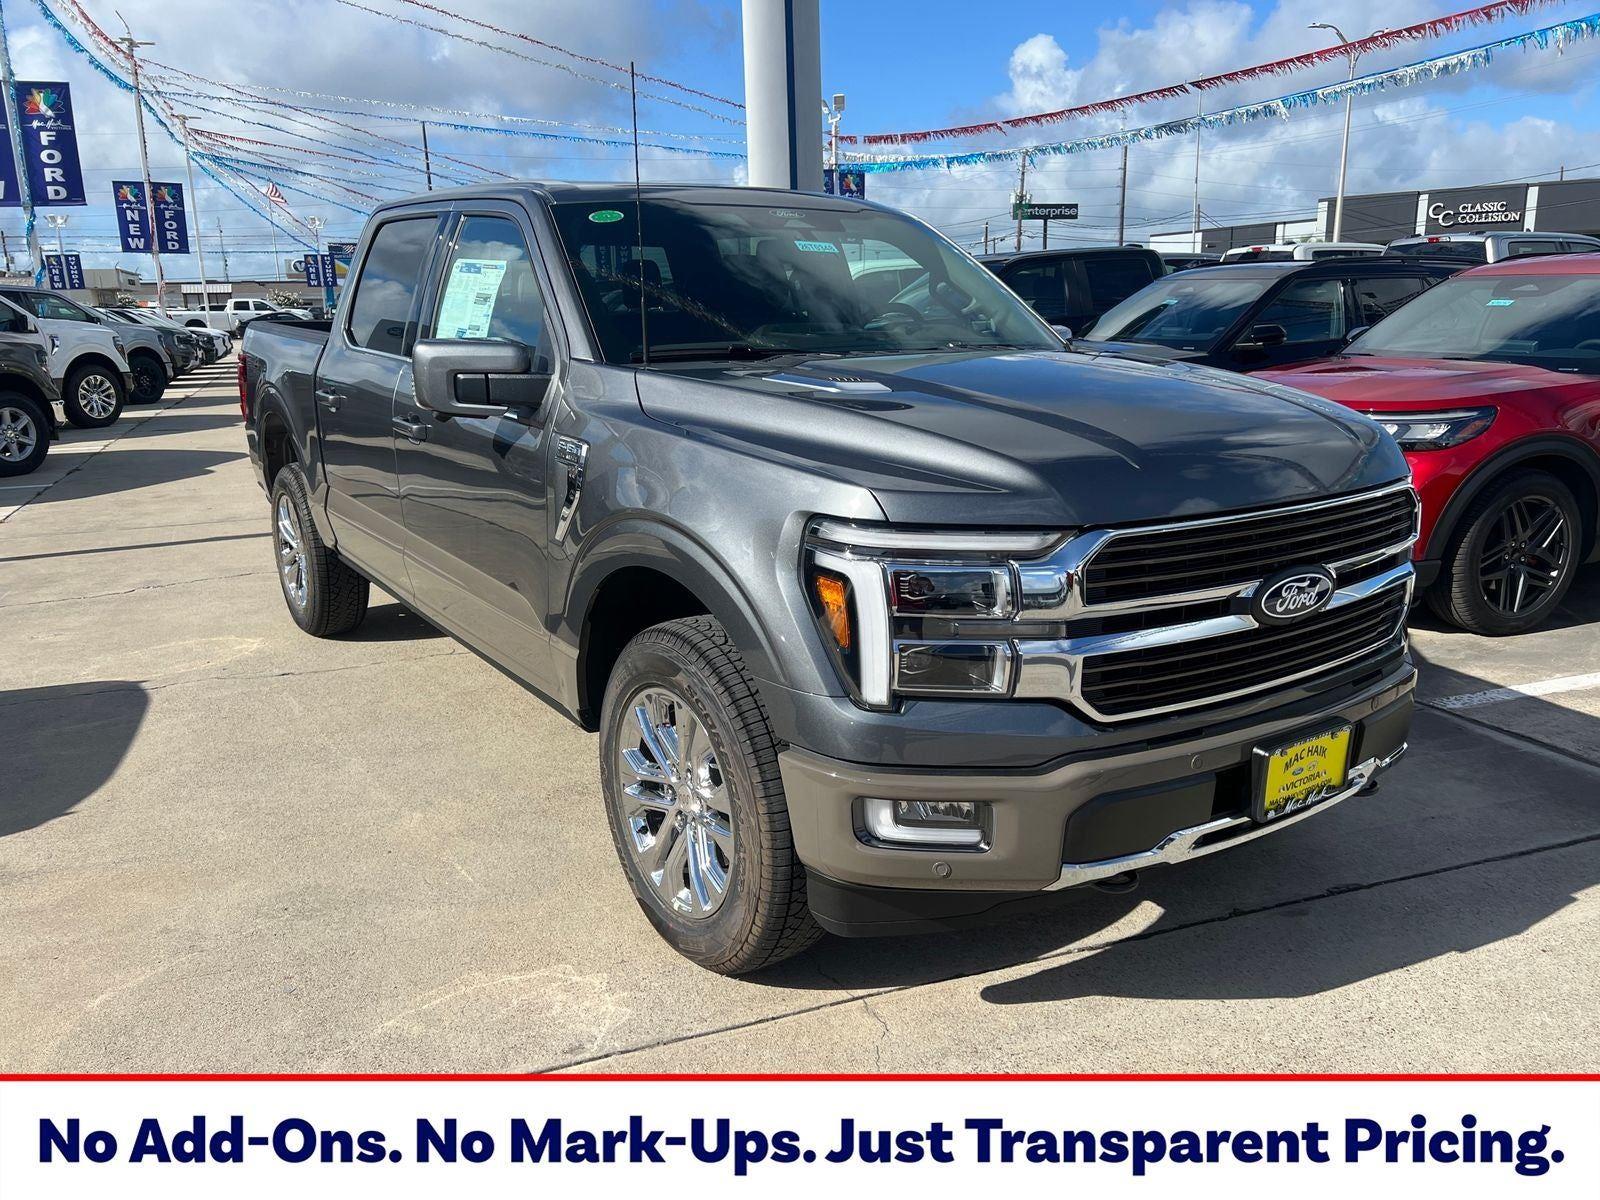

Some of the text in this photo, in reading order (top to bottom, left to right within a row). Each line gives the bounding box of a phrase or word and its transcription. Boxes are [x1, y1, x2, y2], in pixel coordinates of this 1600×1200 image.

[40, 131, 68, 200] FORD
[1457, 211, 1521, 224] COLLISION
[1459, 201, 1507, 213] CLASSIC
[125, 209, 145, 249] NEW
[164, 210, 180, 250] FORD
[52, 268, 63, 289] NEW
[68, 256, 80, 288] HYUNDAI
[309, 267, 318, 286] NEW
[324, 256, 333, 286] HYUNDAI
[1275, 580, 1320, 613] Ford
[1283, 748, 1306, 774] MAC
[1307, 745, 1328, 759] HAIK
[1285, 770, 1322, 791] VICTORIA
